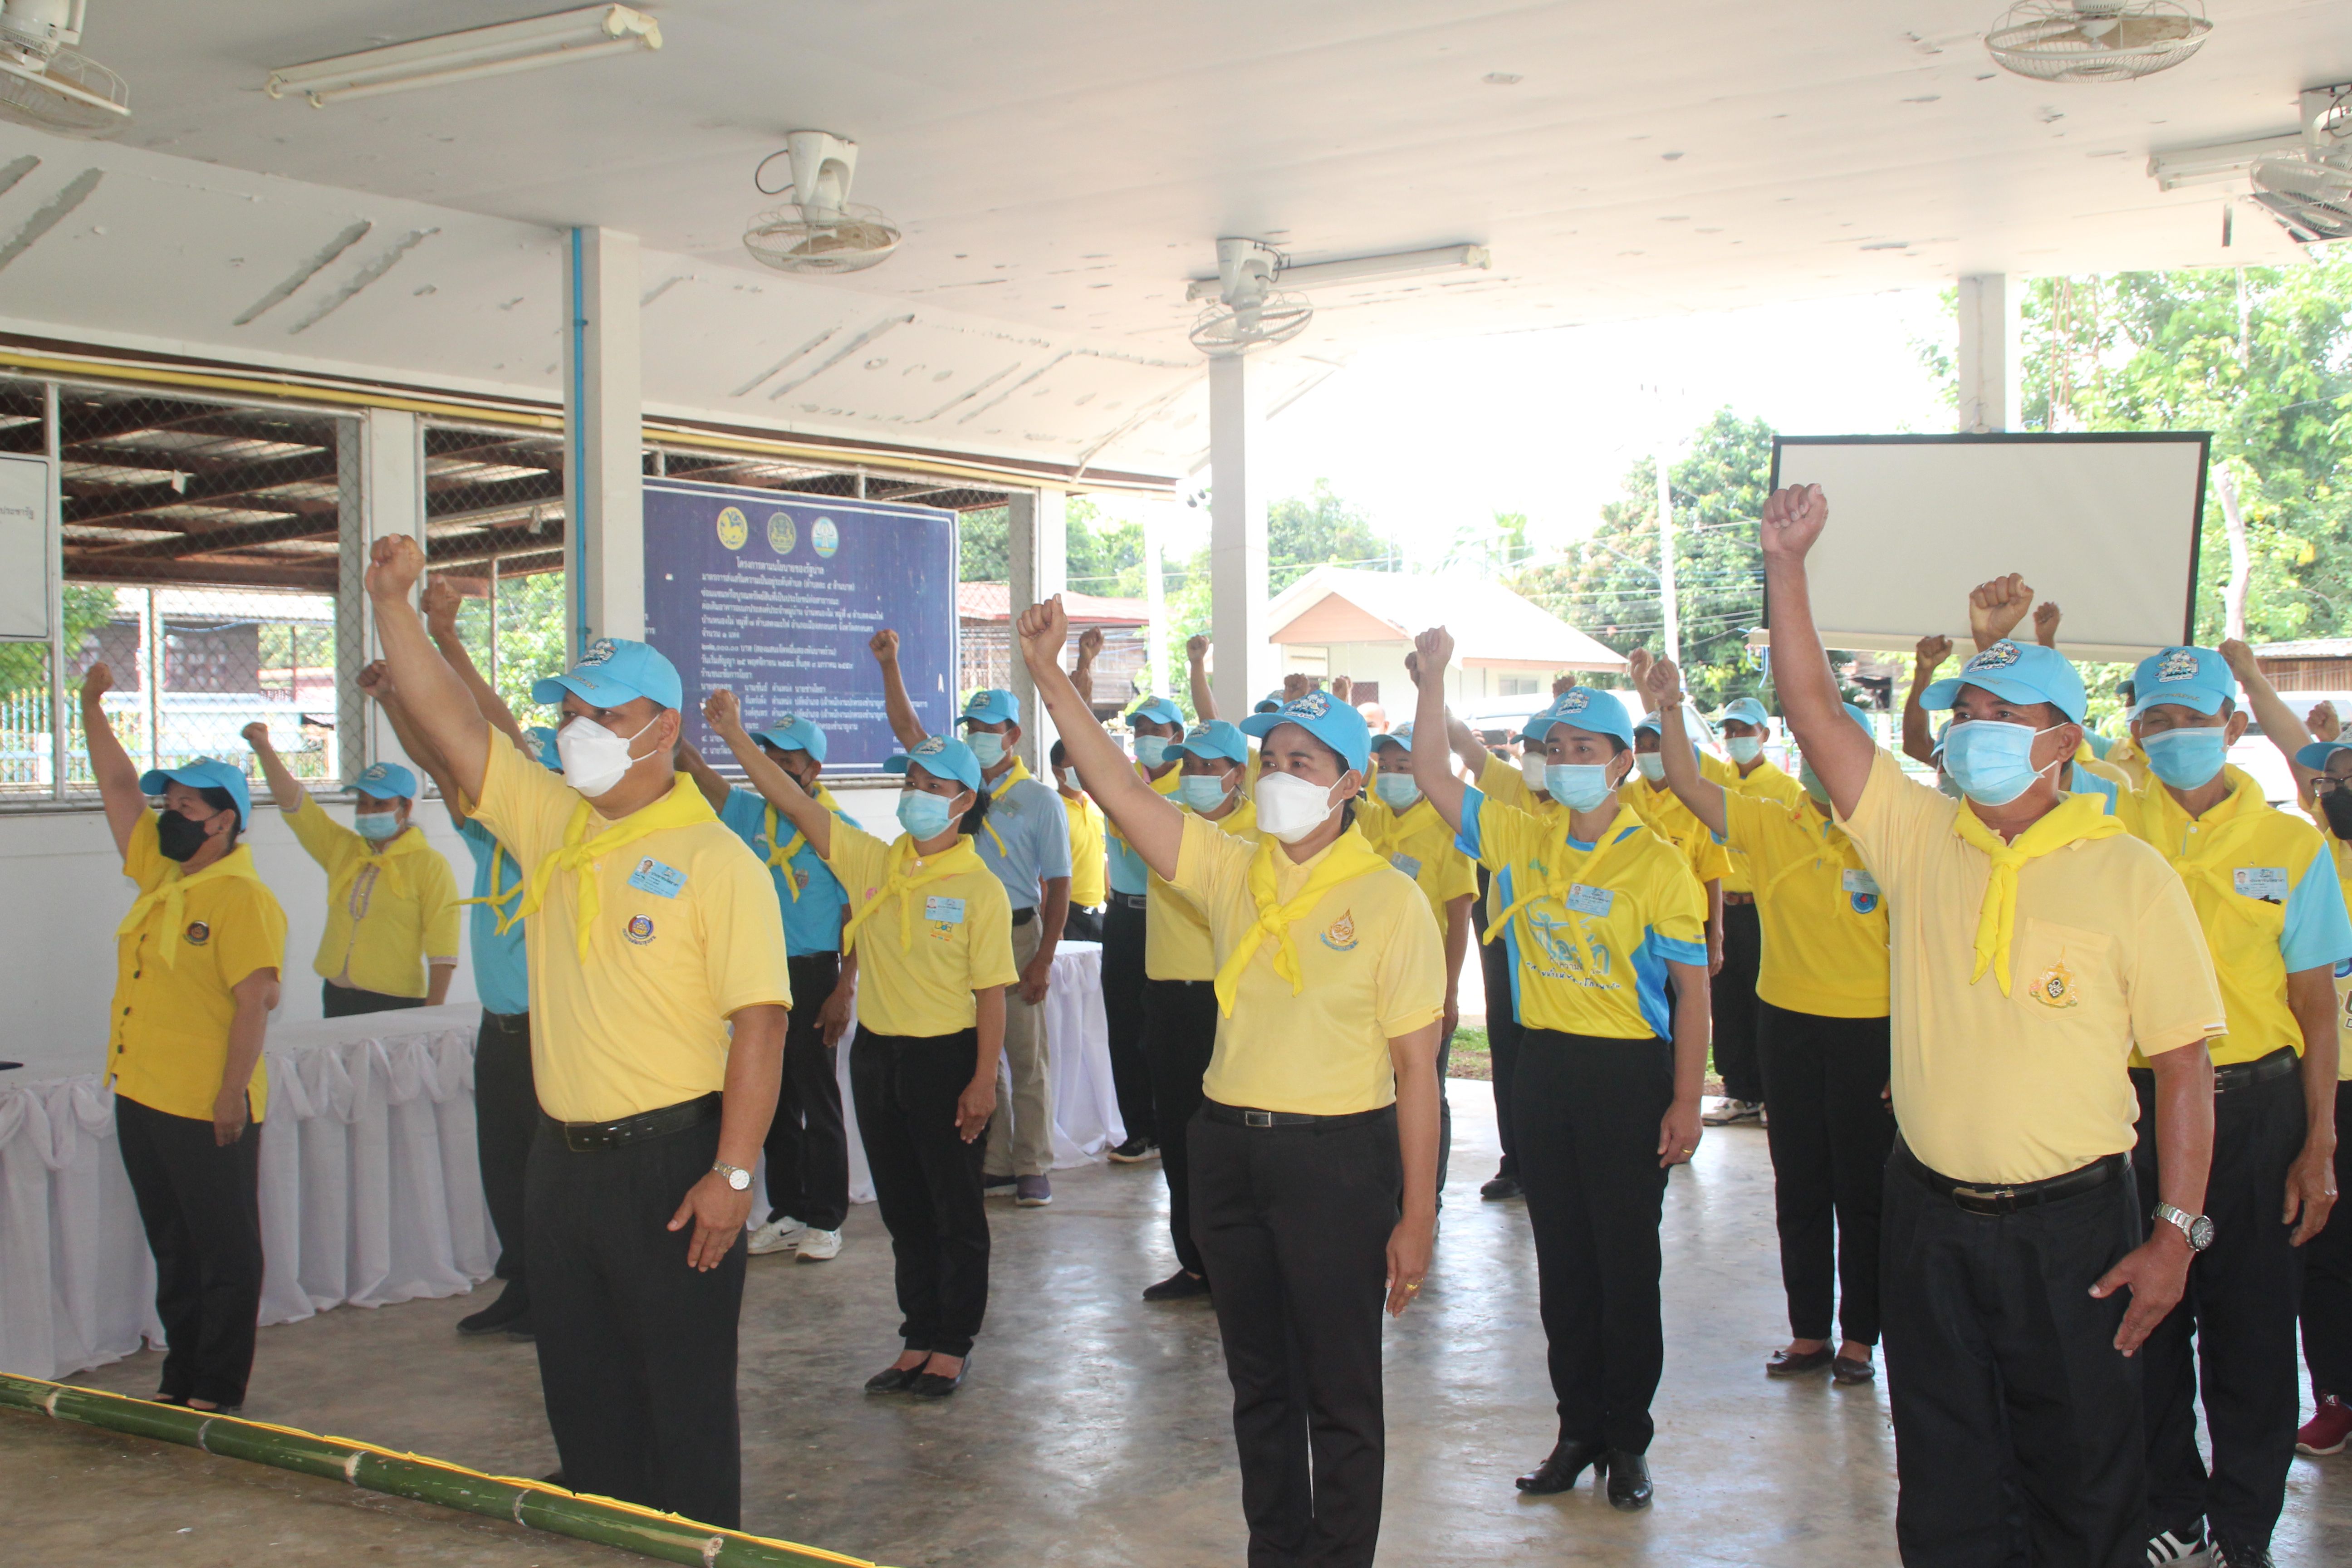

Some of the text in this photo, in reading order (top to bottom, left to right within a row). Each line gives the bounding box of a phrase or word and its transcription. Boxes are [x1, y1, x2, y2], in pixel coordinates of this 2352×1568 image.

[736, 556, 825, 578] โครงการตามนโยบายของรัฐบาล
[701, 627, 721, 638] จำนวน
[728, 629, 740, 638] แห่ง
